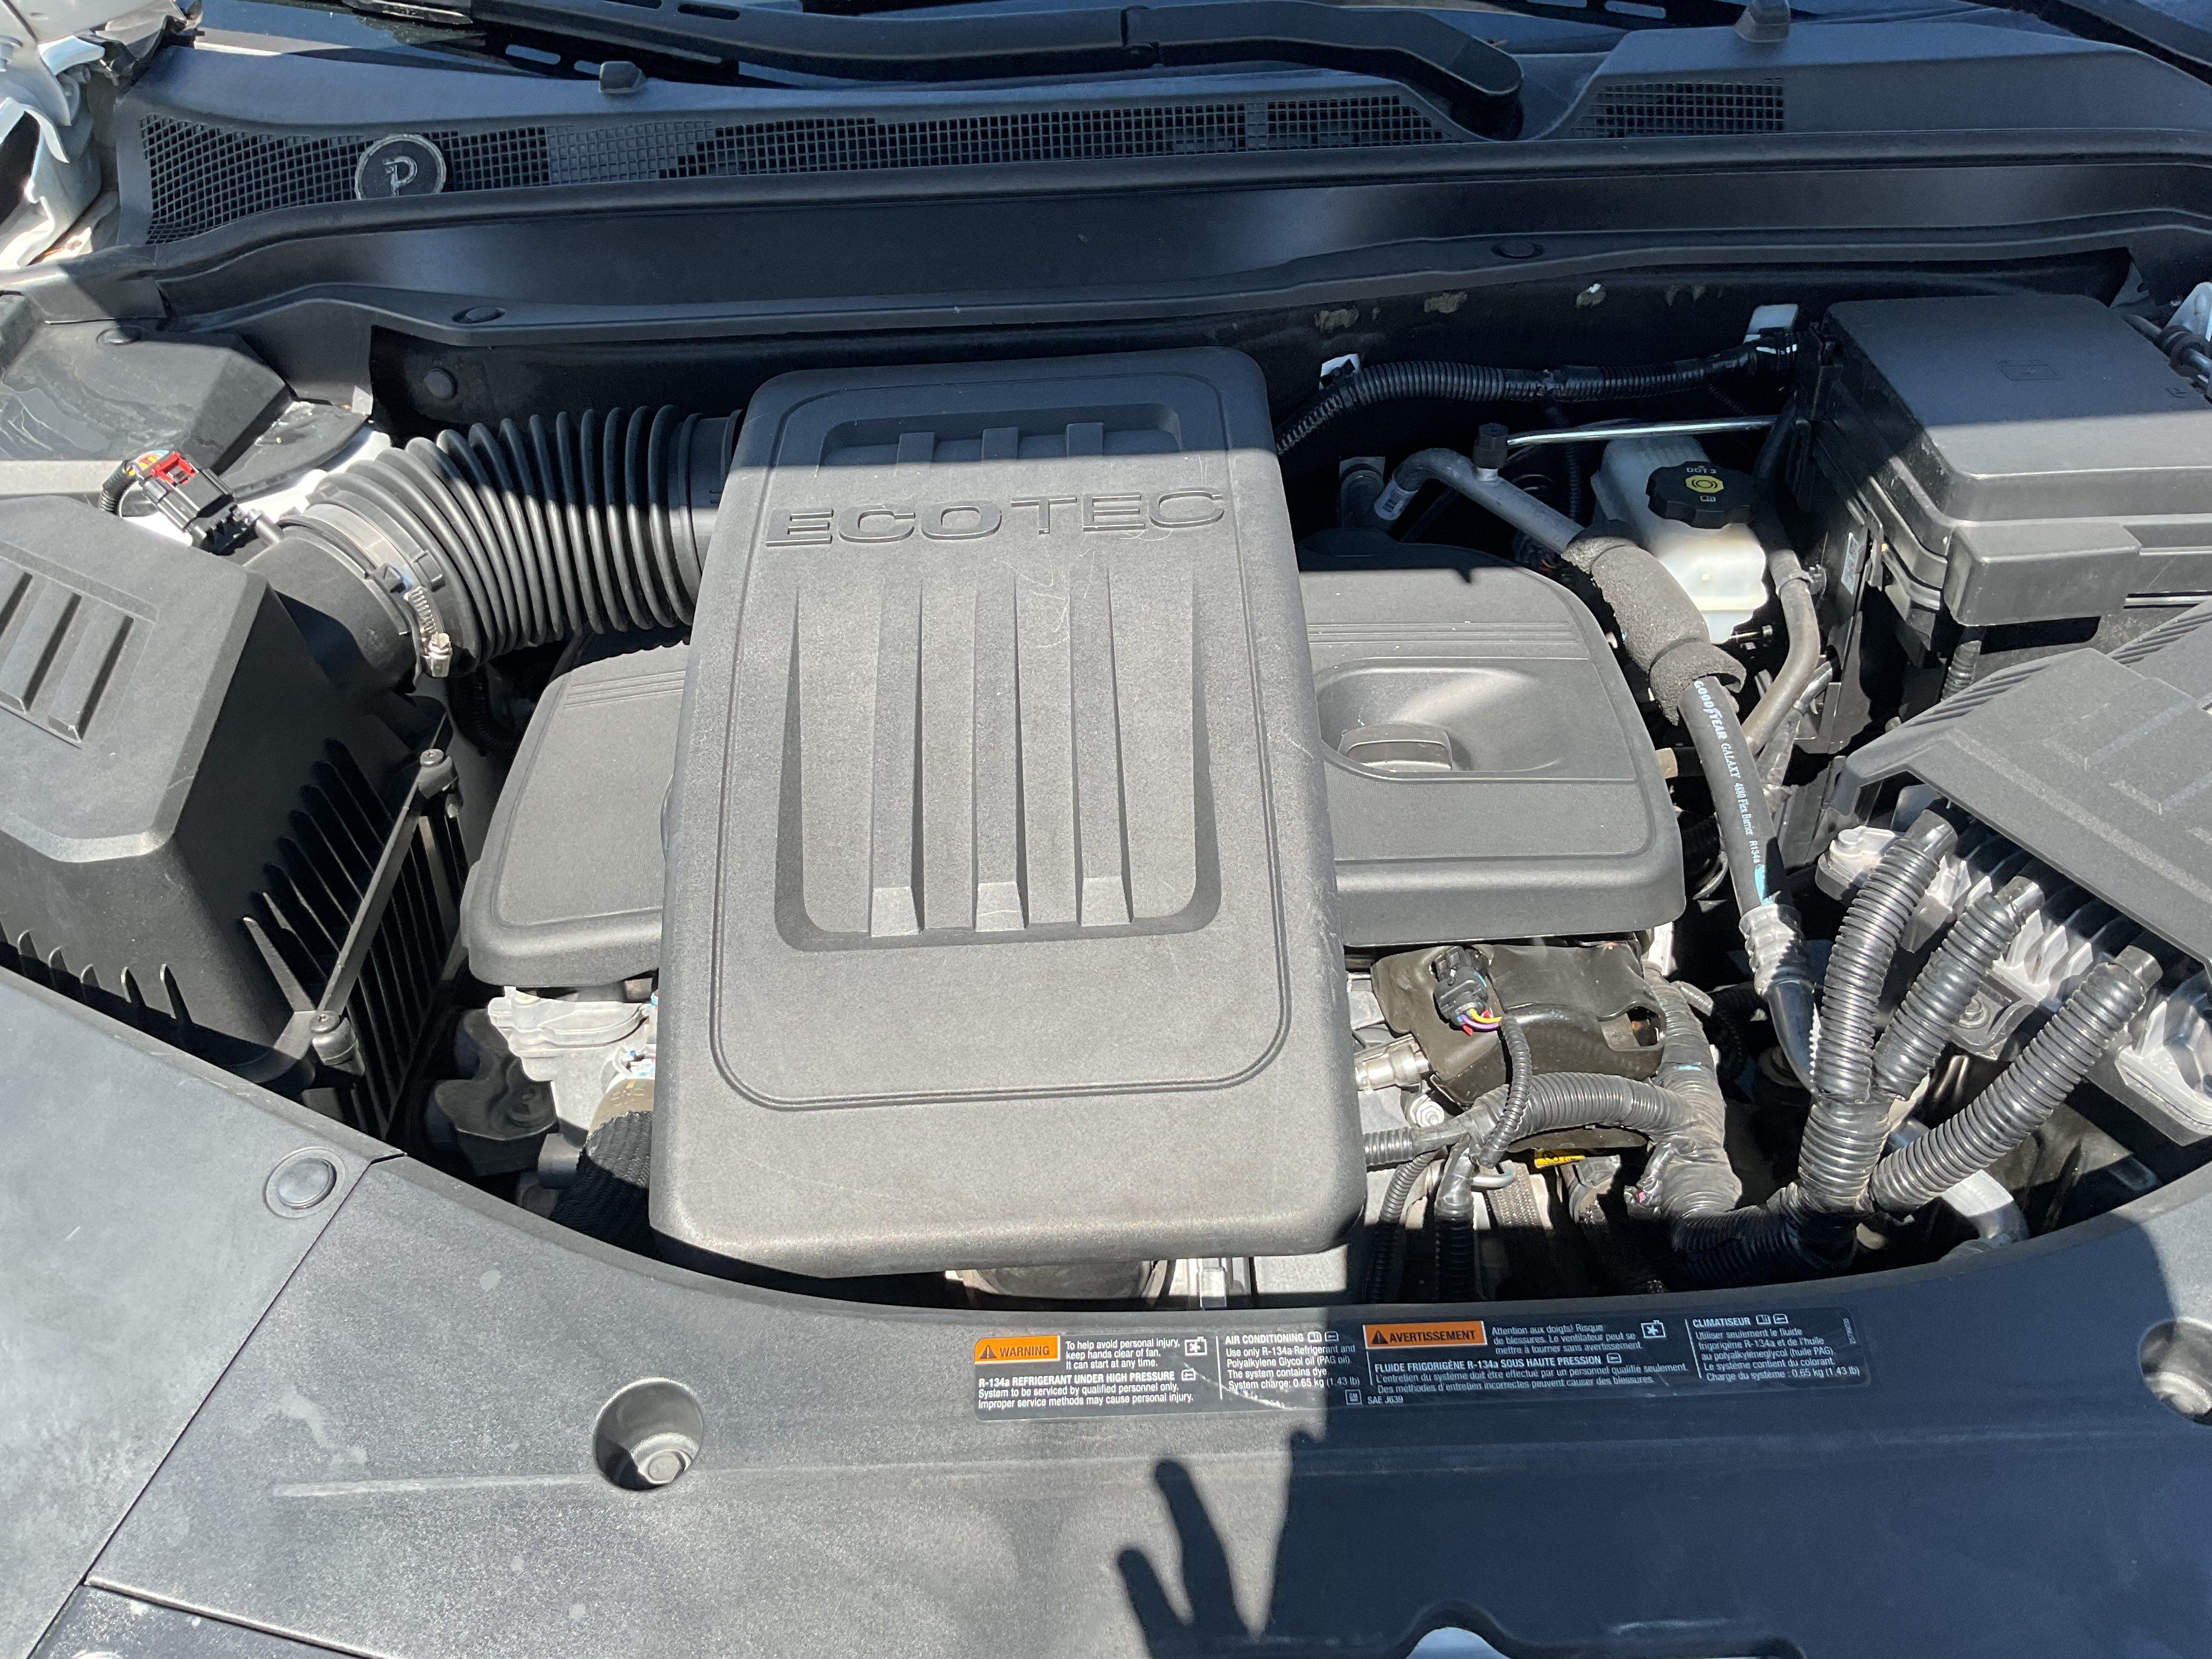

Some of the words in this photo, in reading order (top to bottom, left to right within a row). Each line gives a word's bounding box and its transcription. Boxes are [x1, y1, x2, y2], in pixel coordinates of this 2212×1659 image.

[765, 486, 1225, 548] ECOTEC
[1694, 680, 1728, 740] GOODYEAR
[1720, 742, 1740, 779] GALAXY
[1737, 798, 1750, 814] Flex
[1742, 812, 1754, 836] Barrier
[1748, 840, 1760, 864] R134a
[1693, 1317, 1751, 1327] CLIMATISEUR
[1390, 1330, 1475, 1343] AVERTISSEMENT
[1492, 1327, 1527, 1336] Attention
[1547, 1324, 1573, 1334] doigts!
[1576, 1323, 1604, 1333] Risque
[1696, 1331, 1723, 1340] Utiliser
[1726, 1329, 1769, 1339] seulement
[1770, 1328, 1777, 1337] le
[1780, 1327, 1802, 1336] fluide
[1065, 1341, 1075, 1350] To
[1077, 1340, 1094, 1350] help
[1097, 1339, 1118, 1349] avoid
[1120, 1338, 1154, 1350] personal
[1225, 1335, 1240, 1345] AIR
[1242, 1333, 1304, 1344] CONDITIONING
[1506, 1336, 1547, 1345] blessures.
[1549, 1334, 1559, 1343] Le
[1561, 1333, 1603, 1342] ventilateur
[1606, 1332, 1624, 1342] peut
[1699, 1340, 1742, 1351] frigorigène
[1744, 1339, 1775, 1347] R-134a
[1799, 1336, 1824, 1345] l'huile
[1000, 1345, 1049, 1357] WARNING
[1066, 1349, 1085, 1360] keep
[1088, 1350, 1112, 1359] hands
[1114, 1350, 1134, 1358] clear
[1136, 1348, 1143, 1357] of
[1146, 1348, 1161, 1357] fan.
[1226, 1348, 1241, 1357] Use
[1243, 1347, 1260, 1357] only
[1262, 1346, 1292, 1356] R-134a
[1294, 1344, 1338, 1355] Refrigerant
[1341, 1344, 1356, 1352] and
[1496, 1346, 1522, 1355] mettre
[1524, 1345, 1530, 1353] à
[1584, 1341, 1644, 1351] avertissement.
[1790, 1347, 1812, 1357] (huile
[1813, 1346, 1836, 1355] PAG).
[1073, 1360, 1088, 1370] can
[1091, 1359, 1109, 1368] start
[1110, 1359, 1119, 1368] at
[1121, 1359, 1136, 1369] any
[1138, 1358, 1158, 1367] time.
[1227, 1358, 1276, 1369] Polyalkylene
[1279, 1357, 1303, 1368] Glycol
[1305, 1357, 1314, 1365] oil
[1317, 1356, 1335, 1366] (PAG
[1338, 1355, 1352, 1364] oil).
[1375, 1363, 1405, 1372] FLUIDE
[1407, 1359, 1465, 1371] FRIGORIGÈNE
[1467, 1359, 1498, 1369] R-134a
[1500, 1359, 1524, 1368] SOUS
[1526, 1357, 1555, 1367] HAUTE
[1557, 1355, 1601, 1365] PRESSION
[1703, 1362, 1714, 1370] Le
[1716, 1361, 1750, 1372] système
[1753, 1359, 1786, 1368] contient
[1787, 1358, 1798, 1367] du
[1801, 1357, 1836, 1366] colorant.
[979, 1378, 1010, 1387] R-134a
[1012, 1375, 1073, 1386] REFRIGERANT
[1074, 1372, 1104, 1384] UNDER
[1106, 1373, 1127, 1383] HIGH
[1130, 1371, 1175, 1382] PRESSURE
[1227, 1370, 1243, 1379] The
[1245, 1370, 1274, 1379] system
[1276, 1367, 1311, 1377] contains
[1376, 1374, 1418, 1383] L'entretien
[1421, 1373, 1431, 1381] du
[1434, 1372, 1468, 1382] système
[1505, 1369, 1538, 1378] effectué
[1541, 1370, 1554, 1378] par
[1570, 1367, 1609, 1377] personnel
[1611, 1364, 1641, 1375] qualifié
[1644, 1363, 1688, 1372] seulement.
[1707, 1373, 1736, 1382] Charge
[1738, 1372, 1749, 1380] du
[1751, 1371, 1785, 1381] système
[1792, 1369, 1810, 1377] 0.65
[1813, 1368, 1824, 1378] kg
[1826, 1367, 1847, 1377] (1.43
[1849, 1366, 1860, 1376] lb)
[979, 1389, 1008, 1400] System
[1011, 1388, 1018, 1397] to
[1021, 1387, 1031, 1396] be
[1034, 1386, 1068, 1396] serviced
[1070, 1386, 1080, 1396] by
[1082, 1384, 1116, 1396] qualified
[1119, 1383, 1158, 1394] personnel
[1160, 1381, 1179, 1392] only.
[1228, 1380, 1259, 1391] System
[1261, 1379, 1290, 1390] charge:
[1293, 1378, 1312, 1387] 0.65
[1314, 1378, 1324, 1388] kg
[1327, 1376, 1348, 1386] (1.43
[1350, 1376, 1360, 1386] lb)
[1378, 1385, 1393, 1393] Des
[1396, 1383, 1436, 1392] méthodes
[1438, 1382, 1481, 1392] d'entretien
[1484, 1380, 1530, 1389] incorrectes
[1531, 1379, 1564, 1389] peuvent
[1566, 1377, 1593, 1386] causer
[1596, 1376, 1612, 1385] des
[1613, 1376, 1655, 1384] blessures.
[978, 1400, 1015, 1410] Improper
[1018, 1398, 1046, 1408] service
[1049, 1396, 1084, 1406] methods
[1086, 1396, 1104, 1406] may
[1105, 1395, 1130, 1404] cause
[1132, 1393, 1167, 1404] personal
[1169, 1392, 1194, 1403] injury.
[1385, 1395, 1403, 1403] J639
